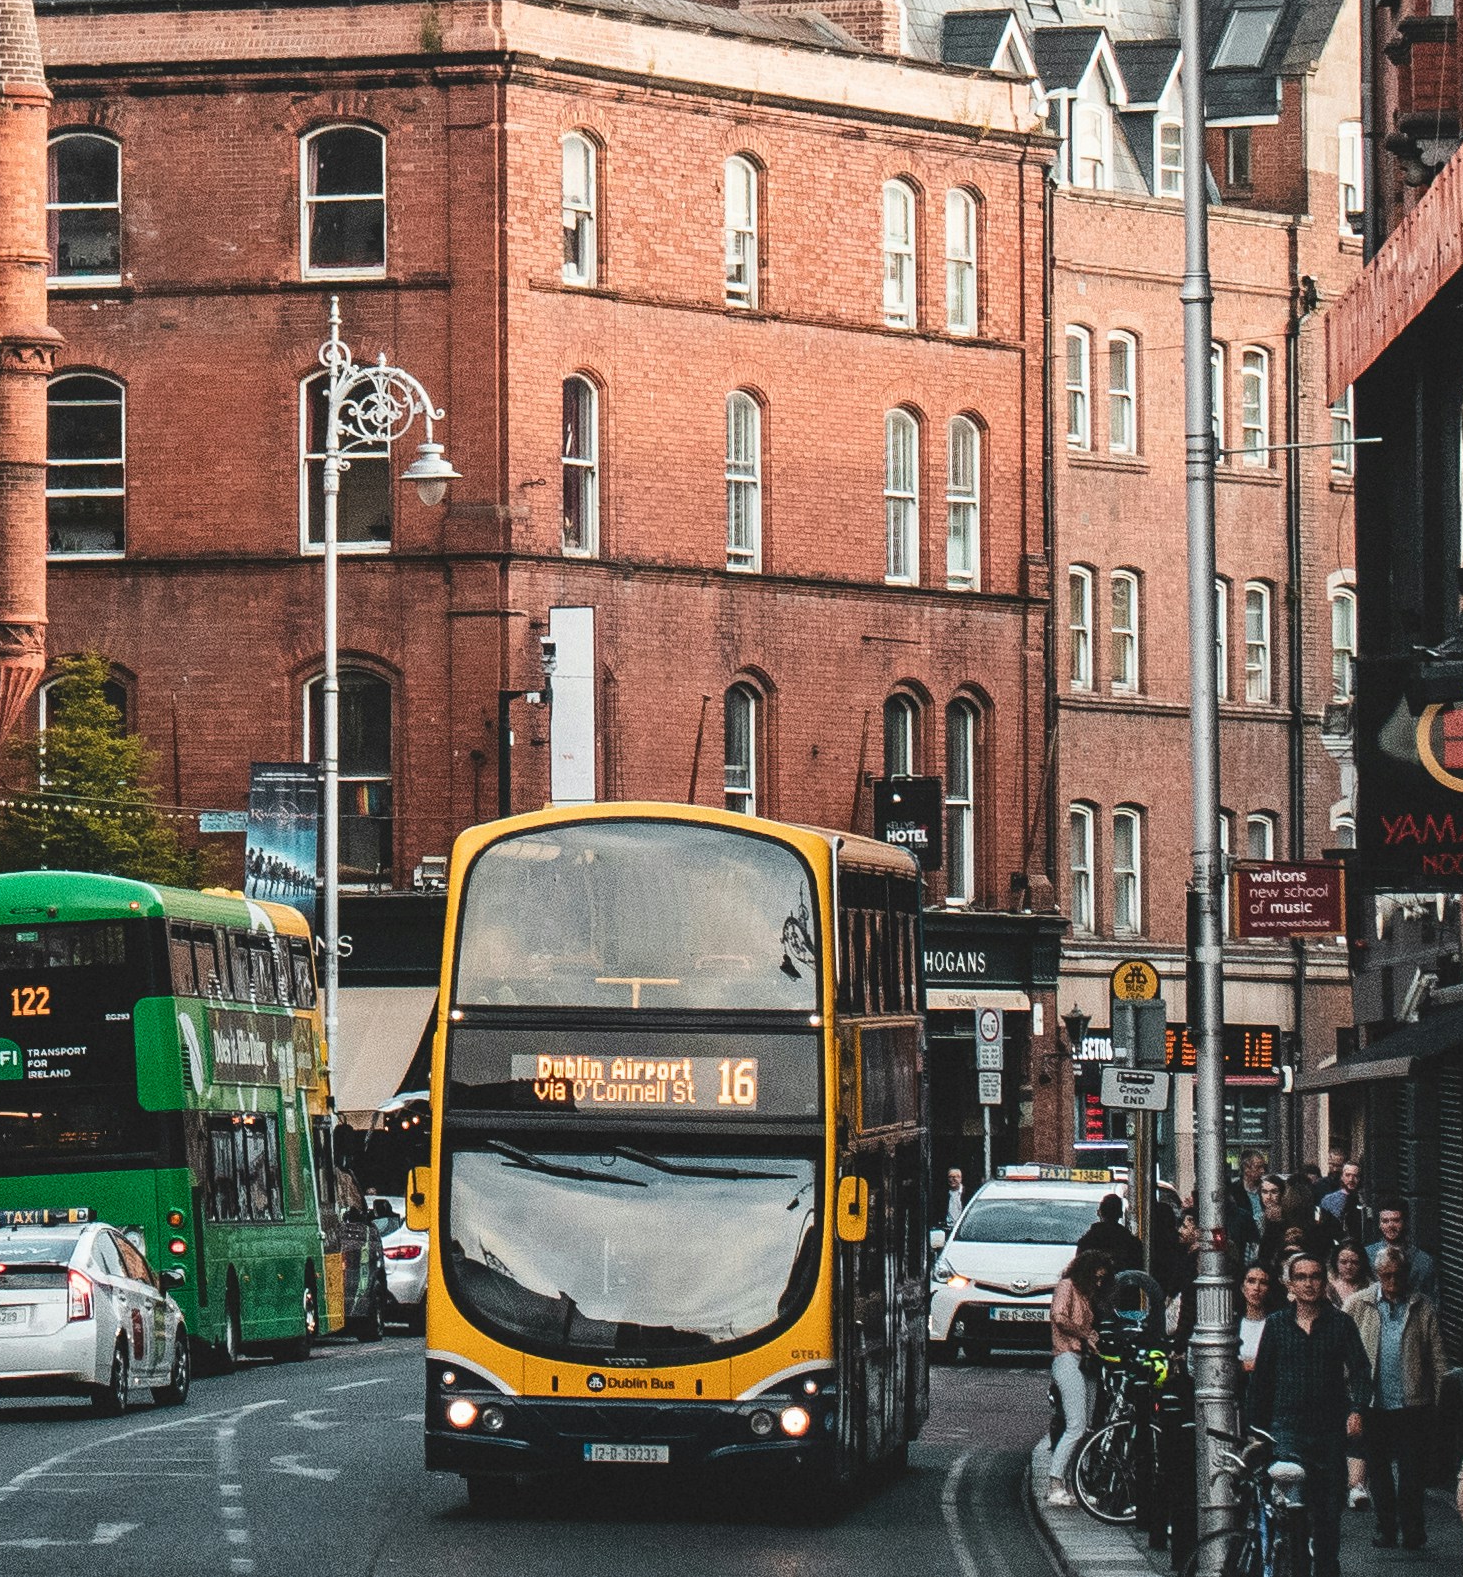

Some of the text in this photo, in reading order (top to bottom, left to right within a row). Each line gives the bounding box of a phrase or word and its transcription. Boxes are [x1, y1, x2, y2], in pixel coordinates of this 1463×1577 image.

[886, 829, 929, 843] HOTEL
[1249, 870, 1307, 883] waltons
[1249, 884, 1329, 899] new school
[1250, 900, 1313, 914] of music
[924, 951, 986, 973] HOGANS
[11, 986, 51, 1016] 122
[27, 1046, 87, 1057] TRANSPORT
[27, 1059, 48, 1068] FOR
[537, 1055, 693, 1082] Dublin Airport
[27, 1069, 71, 1079] IRELAND
[717, 1058, 755, 1106] 16
[533, 1079, 697, 1105] via O'Connell St
[1123, 1095, 1145, 1105] END
[1040, 1168, 1071, 1181] TAXI
[3, 1209, 40, 1225] TAXI
[607, 1377, 676, 1390] Dublin Bus
